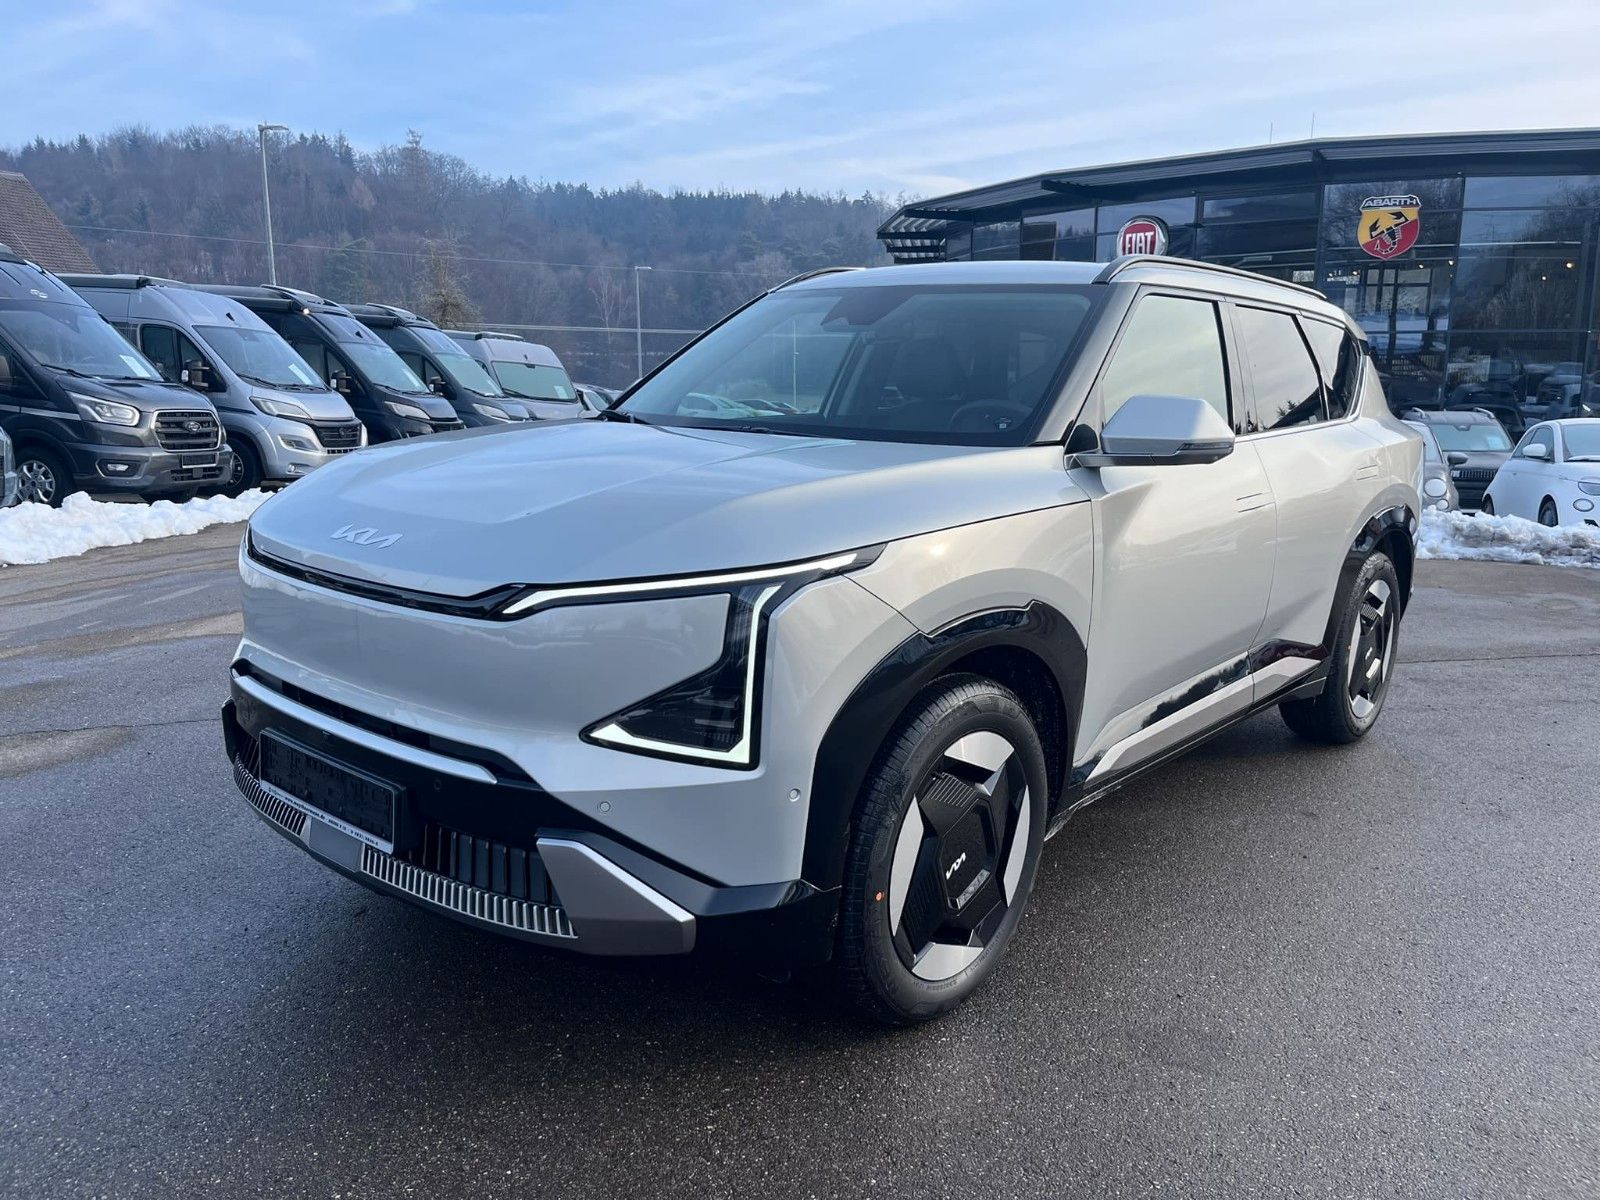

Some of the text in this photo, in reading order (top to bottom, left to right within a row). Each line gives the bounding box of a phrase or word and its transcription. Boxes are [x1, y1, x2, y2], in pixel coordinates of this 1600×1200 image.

[1364, 198, 1416, 207] ABARTH
[1125, 231, 1154, 255] FIAT
[330, 523, 403, 549] KIA
